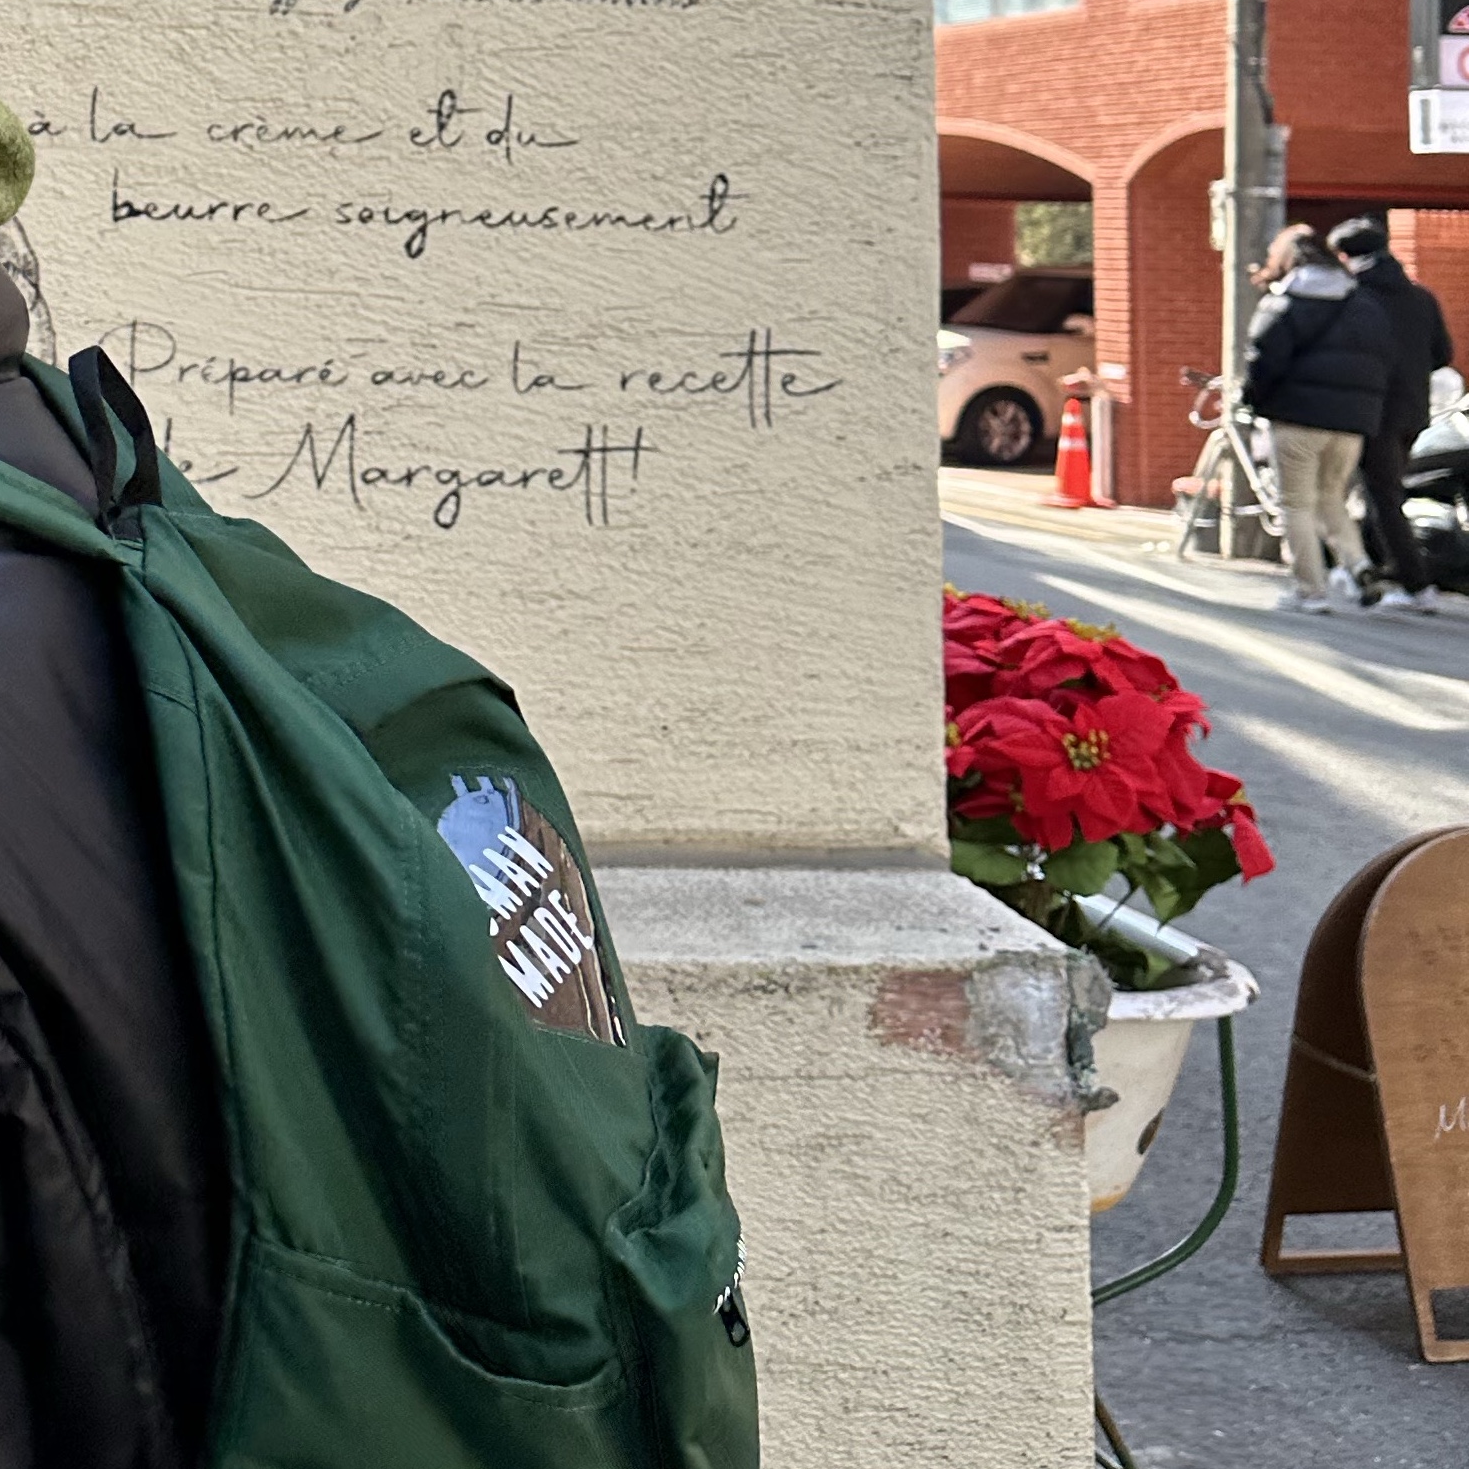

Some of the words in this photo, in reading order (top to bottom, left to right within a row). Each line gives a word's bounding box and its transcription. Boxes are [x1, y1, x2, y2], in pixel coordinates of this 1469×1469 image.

[28, 110, 68, 136] à
[90, 86, 176, 143] la
[206, 114, 382, 147] crème
[410, 89, 482, 148] et
[486, 94, 579, 164] du
[112, 168, 310, 224] beurre
[335, 173, 750, 260] soigneusement
[98, 319, 350, 416] Préparé
[370, 364, 491, 391] avec
[511, 341, 598, 393] la
[620, 326, 843, 428] recette
[468, 826, 554, 936] MAN
[497, 889, 594, 1009] MADE
